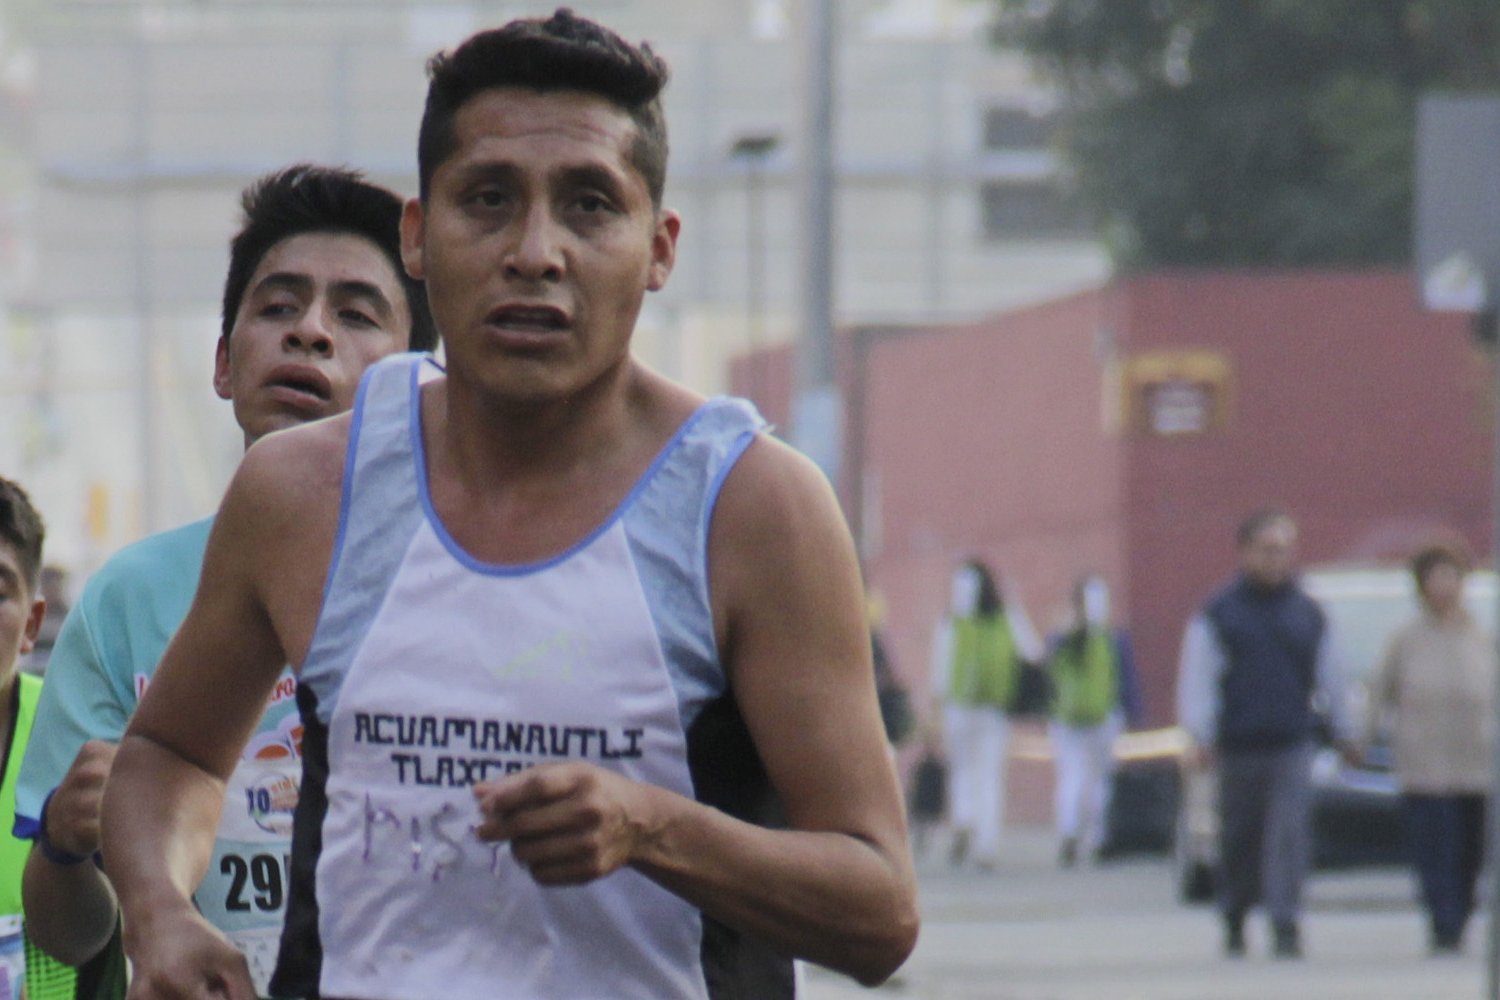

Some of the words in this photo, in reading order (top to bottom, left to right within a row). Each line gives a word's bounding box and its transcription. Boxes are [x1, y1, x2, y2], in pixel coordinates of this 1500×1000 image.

[353, 712, 645, 759] ACUAMANAUTLI
[390, 753, 535, 788] TLAXC
[220, 852, 291, 912] 29
